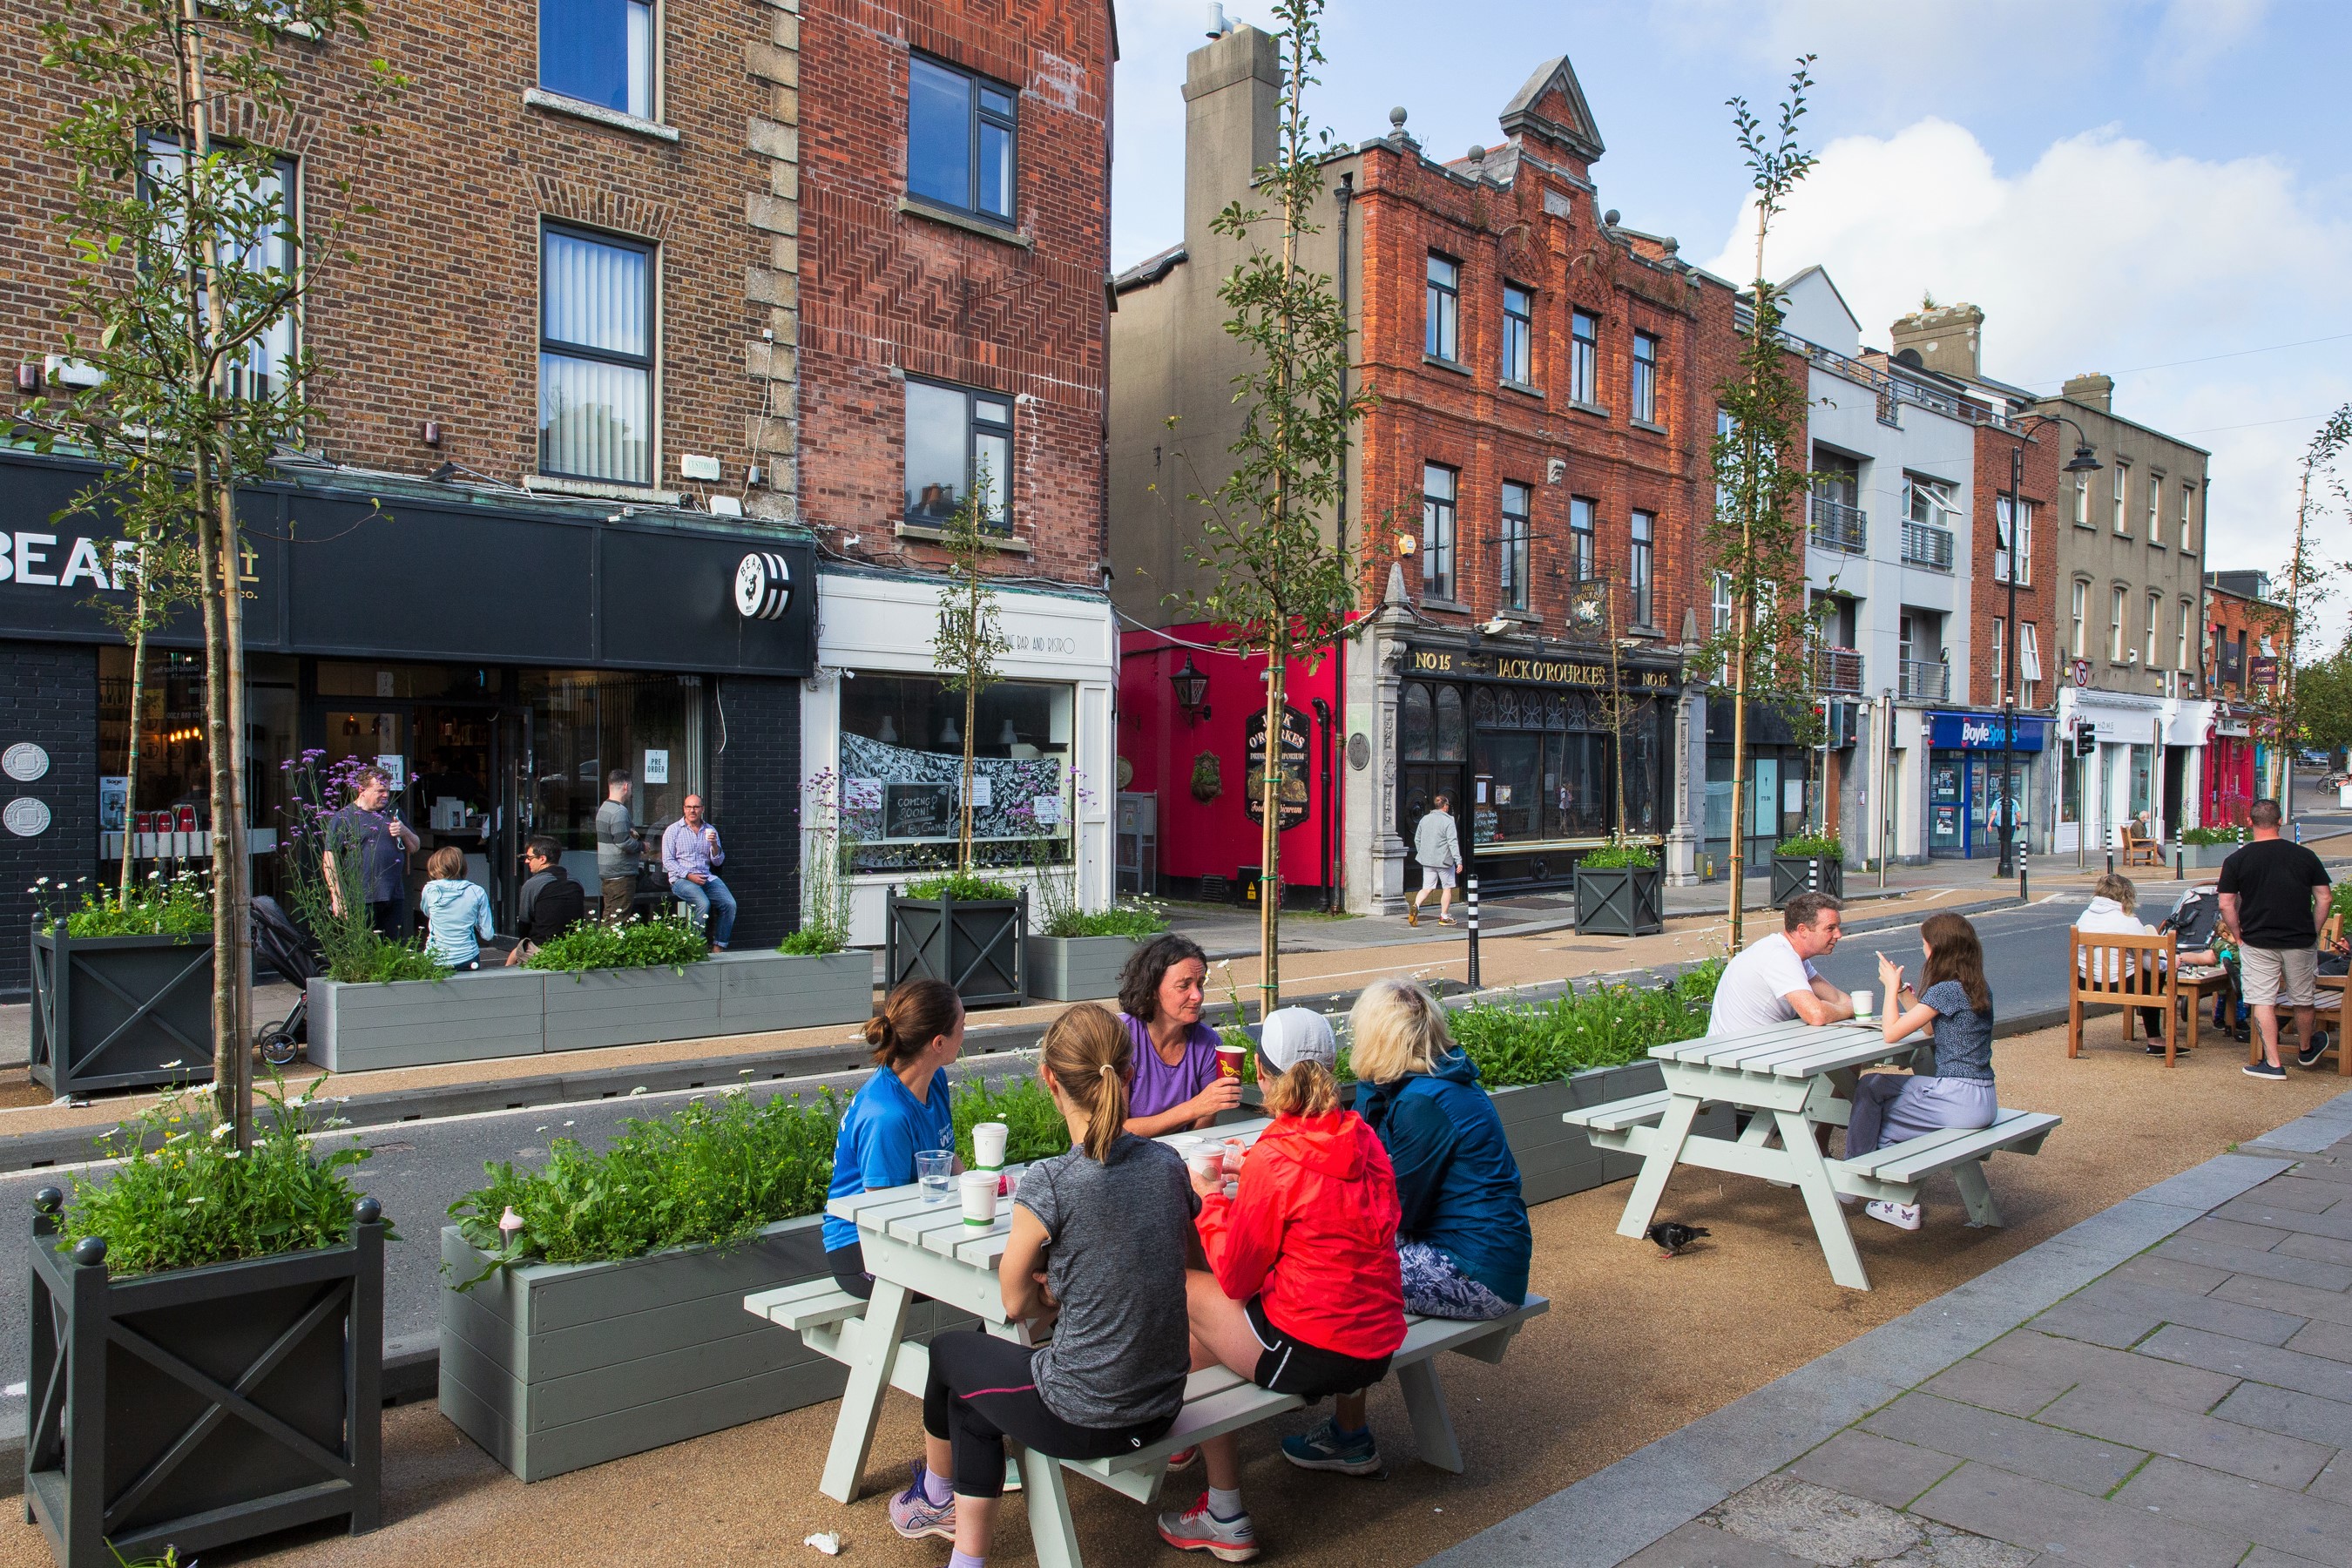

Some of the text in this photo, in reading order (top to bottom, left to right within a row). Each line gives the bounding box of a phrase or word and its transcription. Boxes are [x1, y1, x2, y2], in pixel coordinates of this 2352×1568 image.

[688, 461, 717, 471] CUSTODIAN
[740, 558, 762, 577] BEAR
[1017, 635, 1029, 651] BAR
[1032, 636, 1044, 652] AND
[1048, 637, 1076, 655] BISTRO
[1416, 652, 1436, 669] NO
[1439, 654, 1450, 671] 15
[1497, 659, 1605, 686] JACK O'ROURKES
[1642, 672, 1667, 687] NO 15
[1989, 777, 2000, 787] €10
[897, 797, 930, 808] COMING
